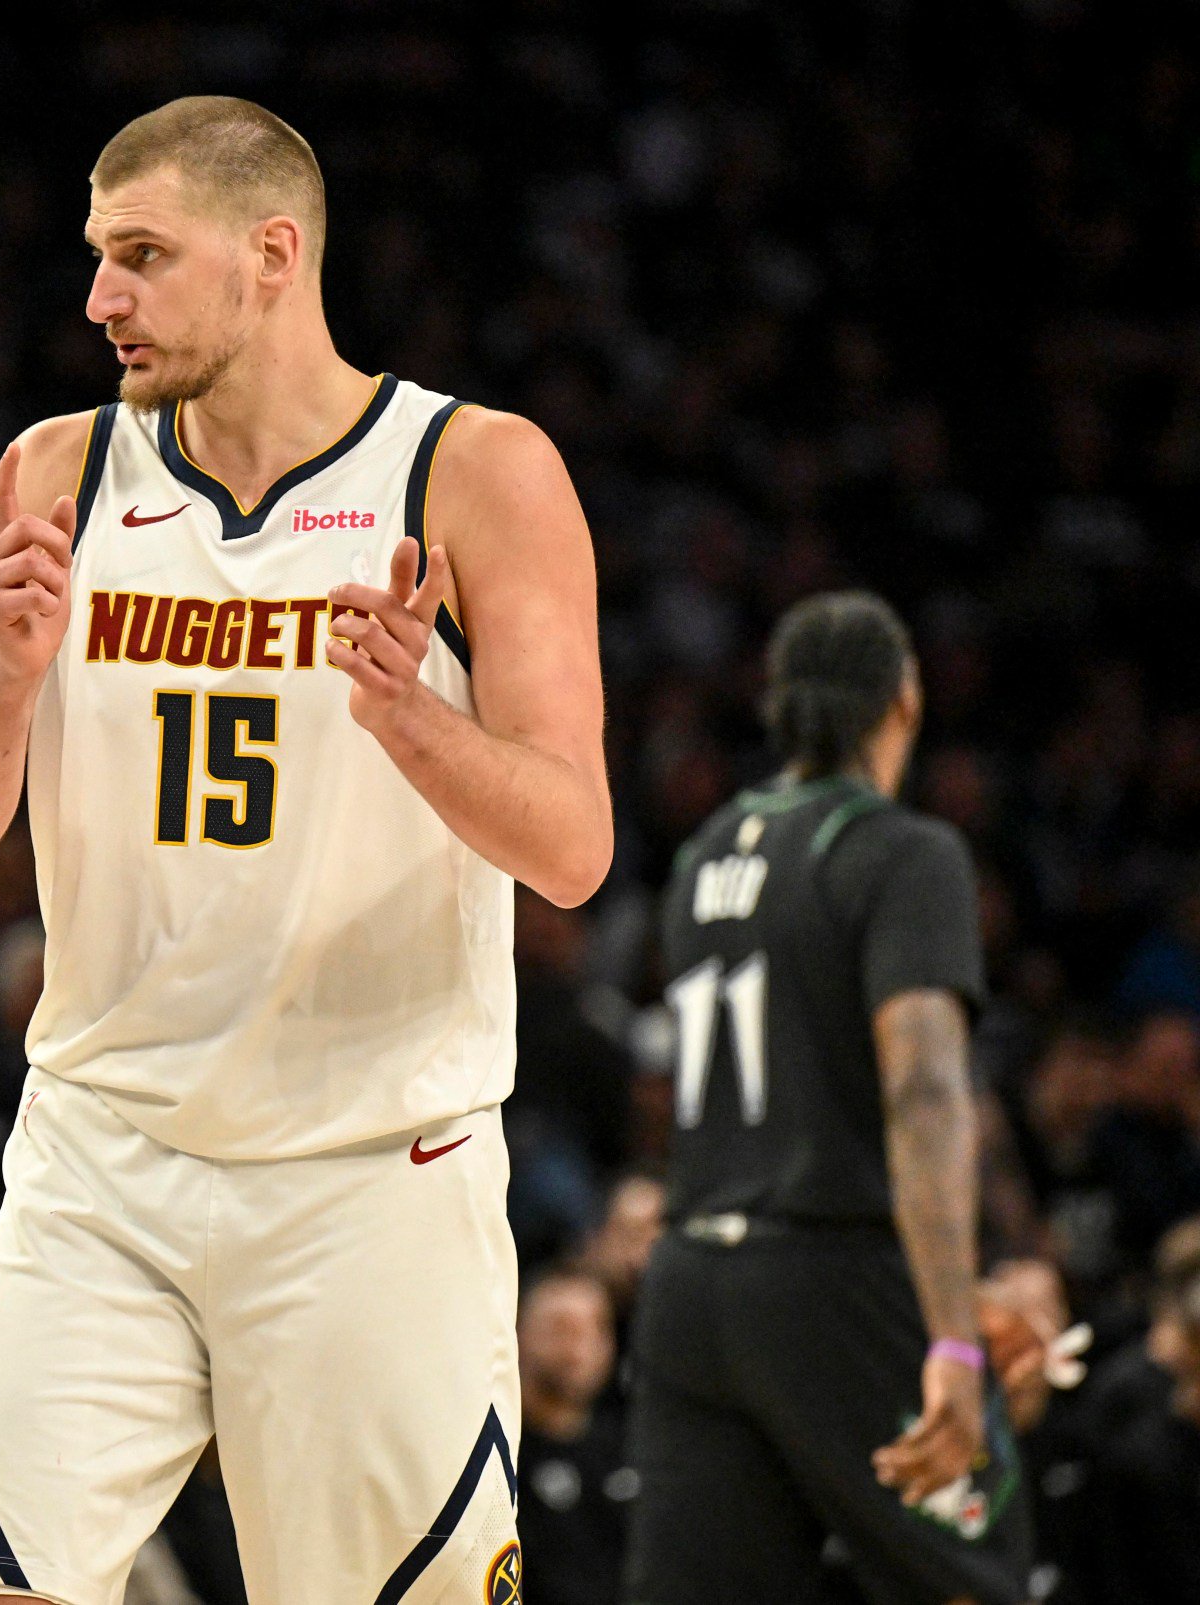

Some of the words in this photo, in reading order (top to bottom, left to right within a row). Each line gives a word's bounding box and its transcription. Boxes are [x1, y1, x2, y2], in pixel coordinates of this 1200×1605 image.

[293, 510, 375, 531] ibotta
[152, 689, 279, 850] 15
[667, 952, 768, 1128] 11
